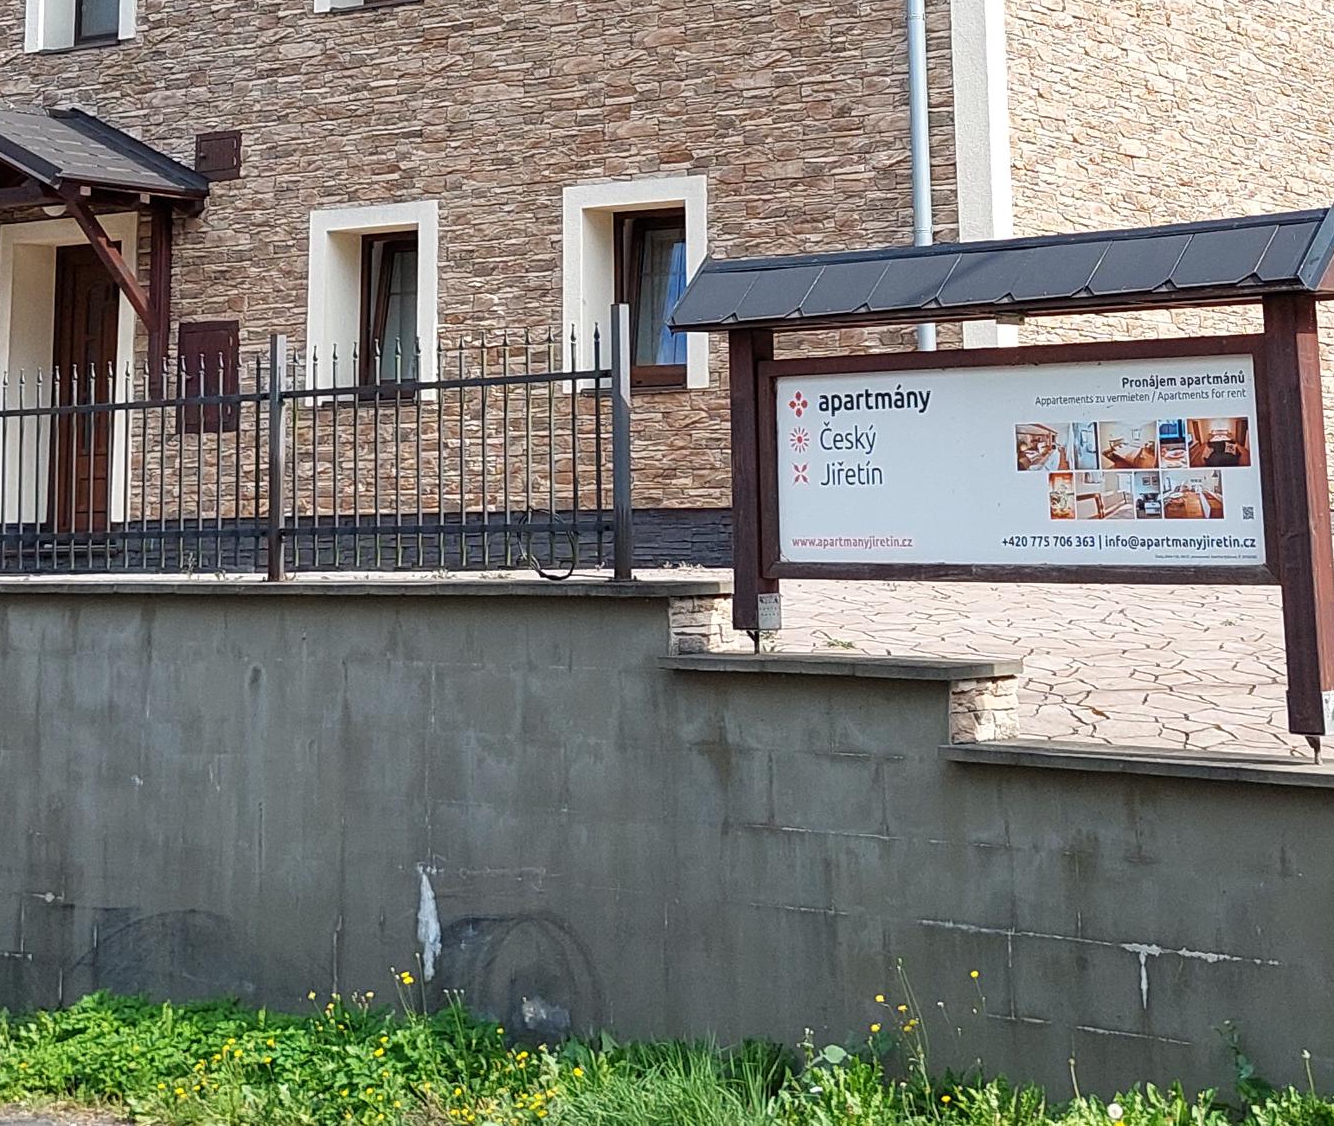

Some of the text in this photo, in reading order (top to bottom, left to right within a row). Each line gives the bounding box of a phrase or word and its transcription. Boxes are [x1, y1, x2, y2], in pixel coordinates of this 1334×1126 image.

[1121, 370, 1245, 390] Pronájem apartmánů
[818, 384, 931, 417] apartmány
[1035, 393, 1094, 406] Appartements
[1095, 394, 1105, 404] zu
[1107, 391, 1150, 403] vermieten
[1157, 390, 1209, 402] Apartments
[1211, 388, 1225, 399] for
[1226, 387, 1246, 399] rent
[819, 421, 876, 455] Český
[820, 460, 884, 486] Jiřetín
[791, 535, 913, 549] www.apartmanyjiretin.cz
[1001, 535, 1028, 548] +420
[1030, 535, 1050, 548] 775
[1052, 535, 1072, 548] 706
[1074, 535, 1095, 548] 363
[1104, 534, 1256, 551] info@apartmanyjiretin.cz
